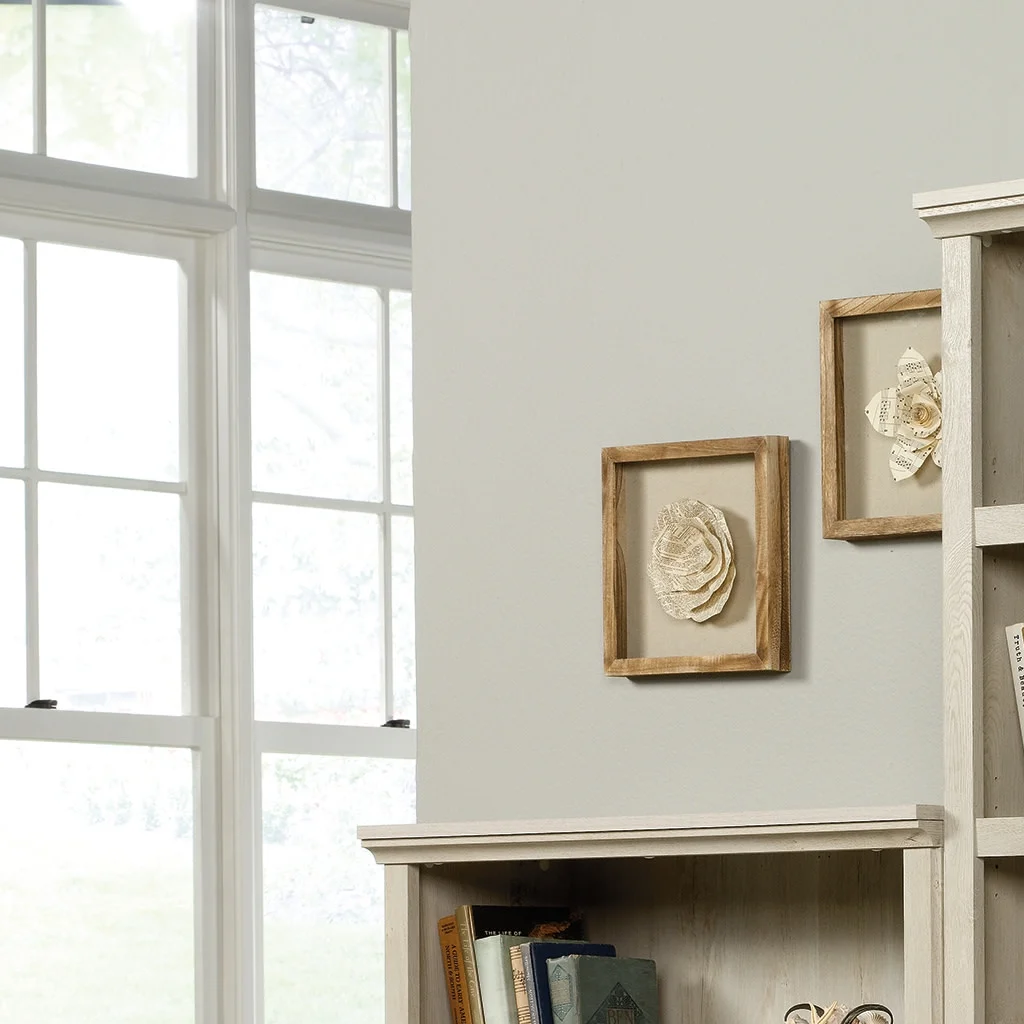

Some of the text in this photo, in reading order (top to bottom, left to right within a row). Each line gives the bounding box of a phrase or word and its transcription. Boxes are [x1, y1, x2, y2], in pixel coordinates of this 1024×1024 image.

[1013, 634, 1023, 662] Truth
[444, 945, 453, 969] NORTH
[450, 949, 459, 971] GUIDE
[448, 976, 456, 1000] SOUTH
[453, 972, 460, 982] TO
[454, 983, 463, 1004] EARLY
